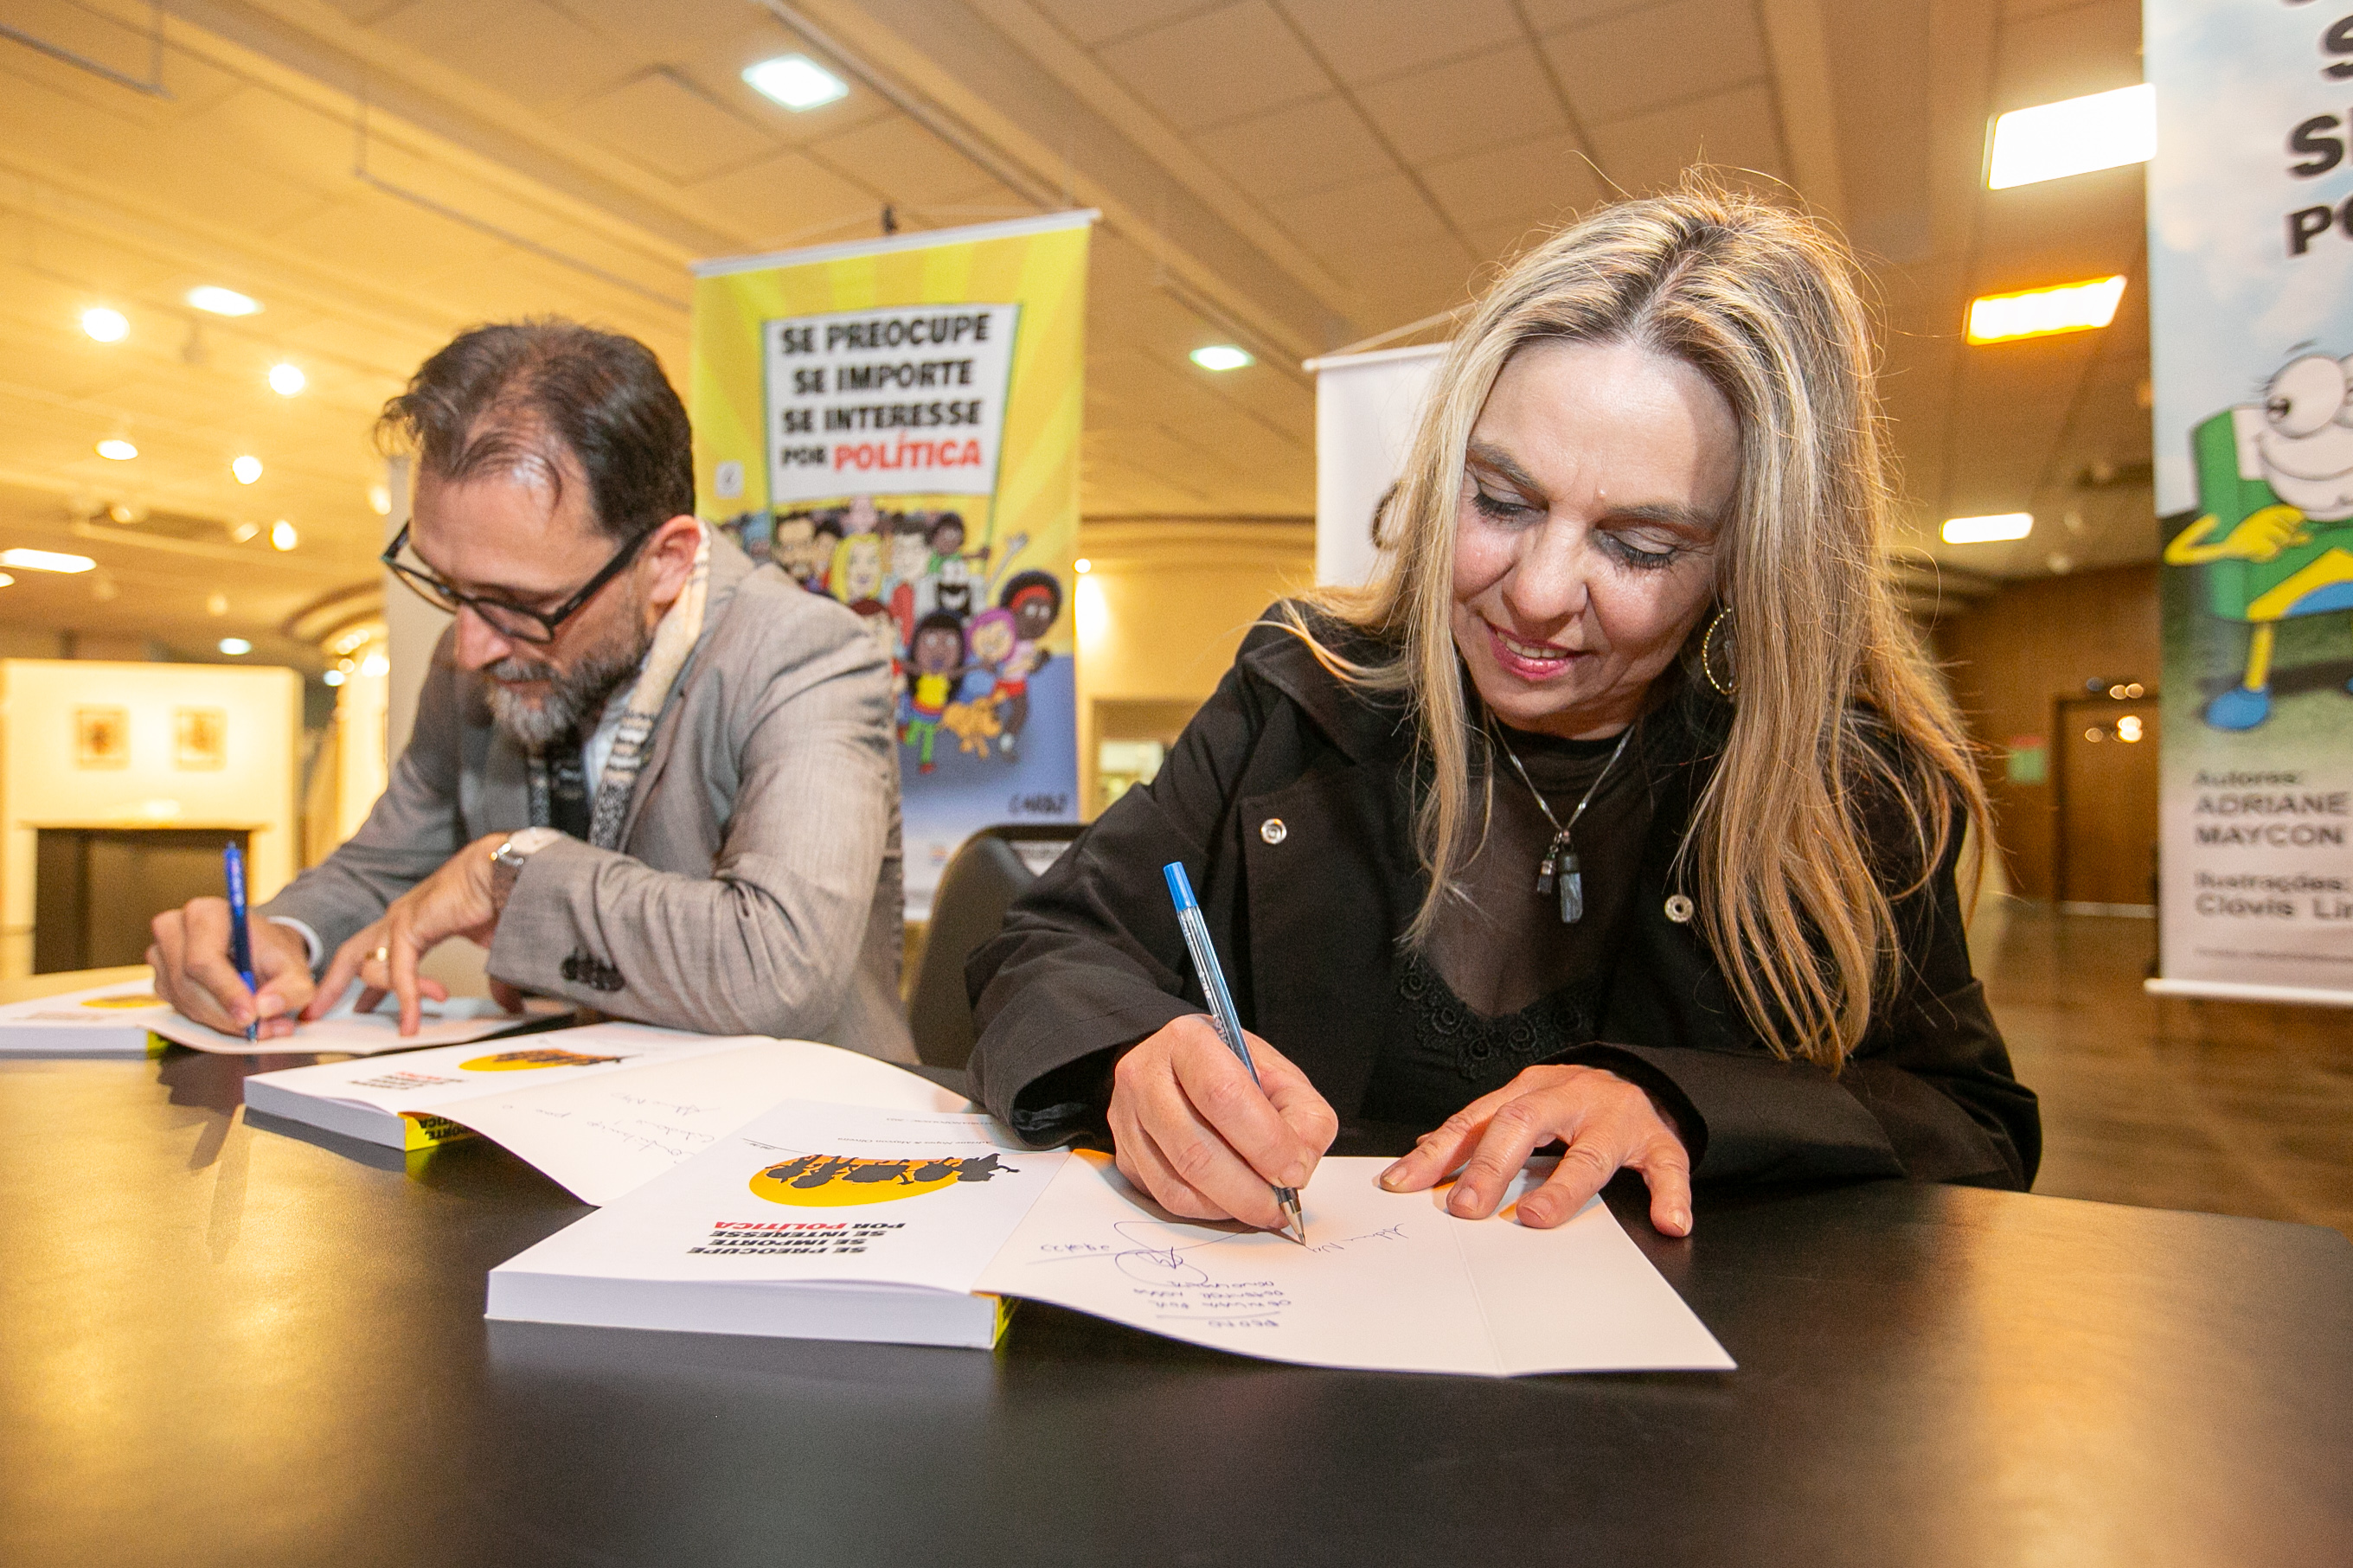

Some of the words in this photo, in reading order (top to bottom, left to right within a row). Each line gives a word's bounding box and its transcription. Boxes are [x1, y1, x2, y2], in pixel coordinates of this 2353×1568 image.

[782, 326, 815, 355] SE
[827, 312, 991, 352] PREOCUPE
[793, 367, 825, 395] SE
[836, 359, 975, 393] IMPORTE
[783, 407, 813, 435] SE
[824, 400, 984, 432] INTERESSE
[781, 446, 825, 469] POR
[834, 431, 983, 471] POLÍTICA
[2194, 791, 2350, 816] ADRIANE
[2195, 824, 2343, 847] MAYCON
[708, 1230, 850, 1238] INTERESSE
[713, 1221, 849, 1232] POLÍTICA
[685, 1246, 829, 1255] PREOCUPE
[707, 1238, 830, 1246] IMPORTE
[832, 1238, 869, 1246] SE
[832, 1246, 869, 1255] SE
